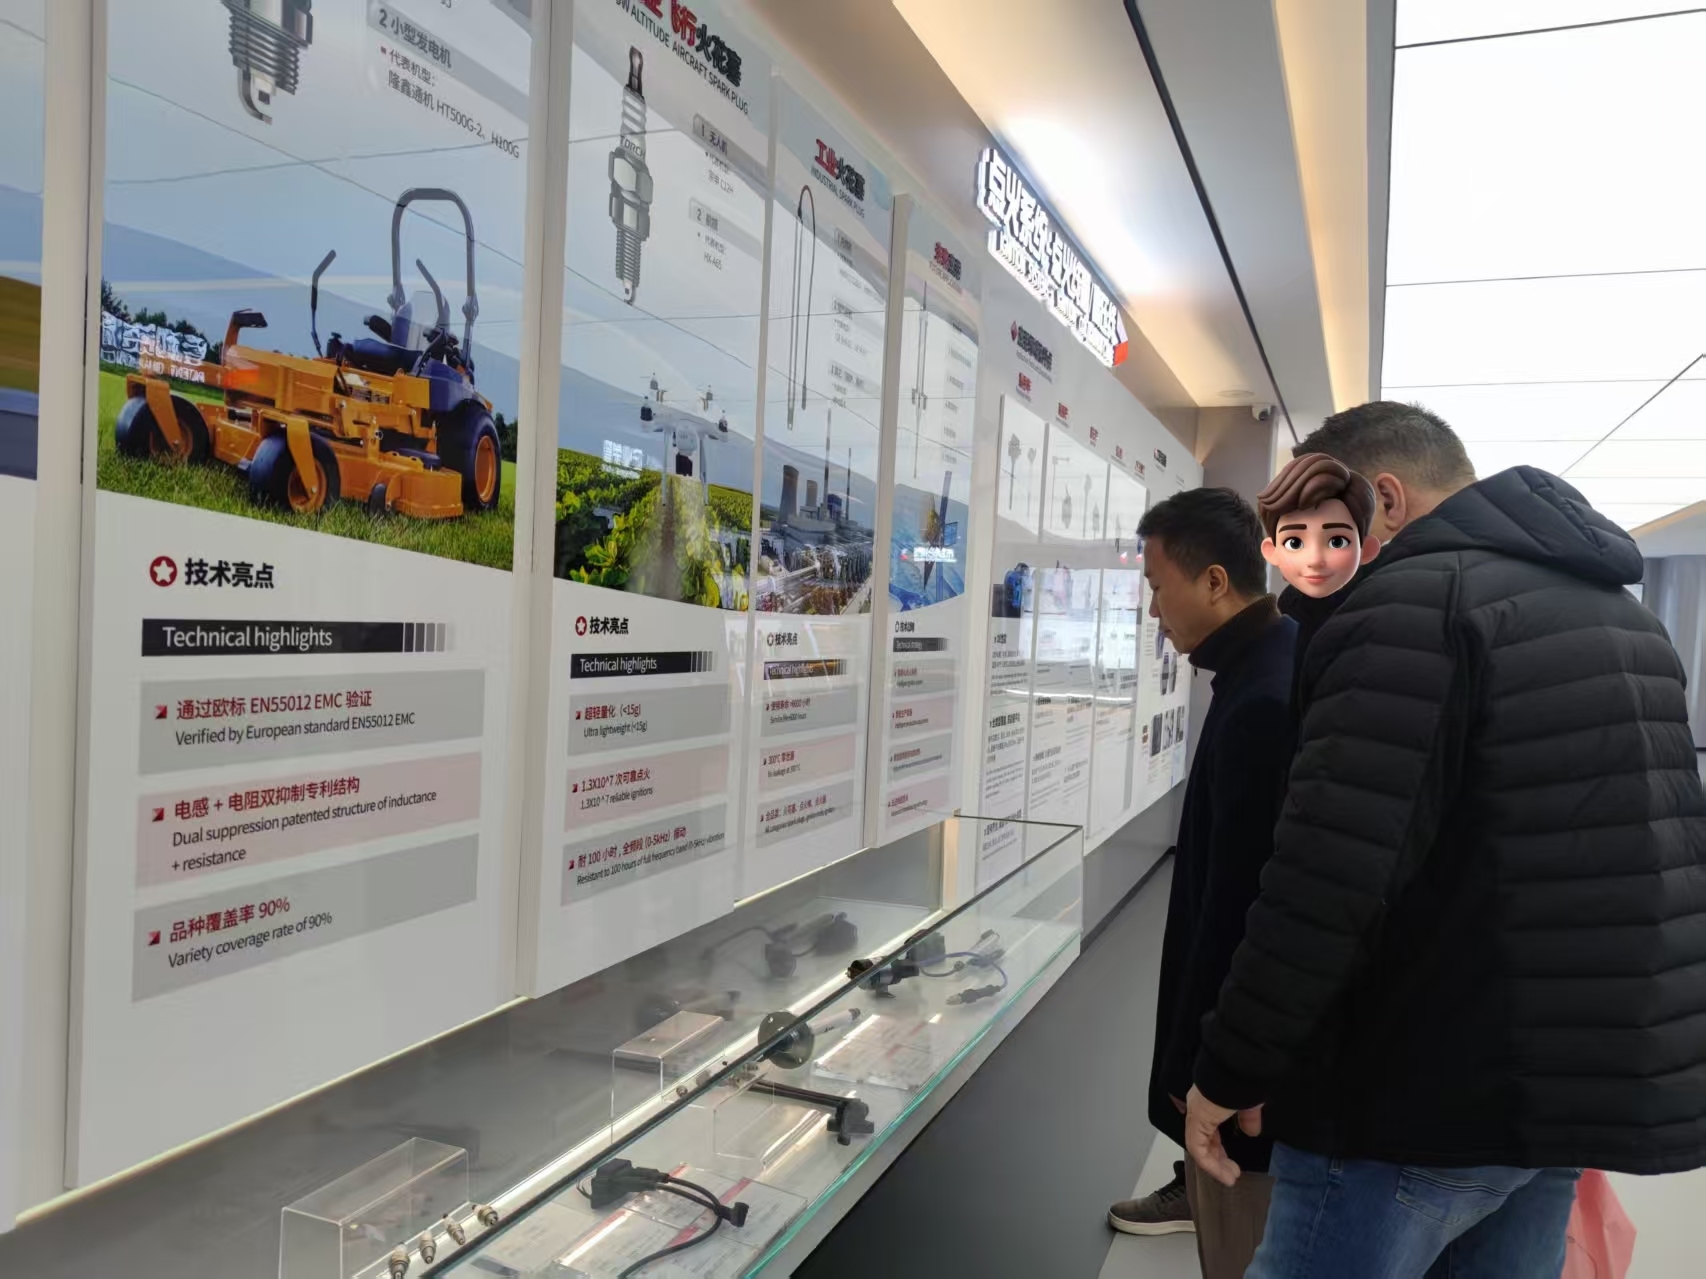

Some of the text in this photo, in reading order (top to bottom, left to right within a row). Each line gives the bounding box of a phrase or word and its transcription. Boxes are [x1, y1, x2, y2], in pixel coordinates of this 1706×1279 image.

[379, 8, 452, 69] 2 小型发电机
[631, 4, 670, 48] ALTITUDE
[672, 41, 708, 80] AIRCRAFT
[708, 72, 730, 101] SPARK
[731, 92, 749, 115] PLUG
[388, 70, 435, 111] 隆鑫通机
[621, 135, 646, 158] TORCH
[184, 558, 275, 589] 技术亮点
[162, 626, 333, 651] Technical highlights
[589, 616, 629, 635] 技术亮点
[580, 657, 657, 674] Technical highlights
[176, 690, 373, 721] 通过欧标 EN55012 EMC 验证
[175, 712, 416, 746] Verified by European standard EN55012 EMC
[583, 726, 599, 738] Ultra
[600, 722, 631, 738] lightweight
[174, 776, 360, 820] 电感 + 电阻双抑制专利结构
[610, 791, 631, 803] reliable
[631, 787, 653, 800] ignitions
[172, 790, 437, 847] Dual suppression patented structure of inductance
[172, 847, 247, 872] + resistance
[577, 869, 603, 886] Resistant
[604, 868, 610, 878] to
[611, 863, 621, 875] 100
[622, 860, 636, 871] hours
[588, 851, 600, 865] 100
[169, 897, 291, 943] 品种覆盖率 90%
[168, 911, 333, 969] Variety coverage rate of 90%
